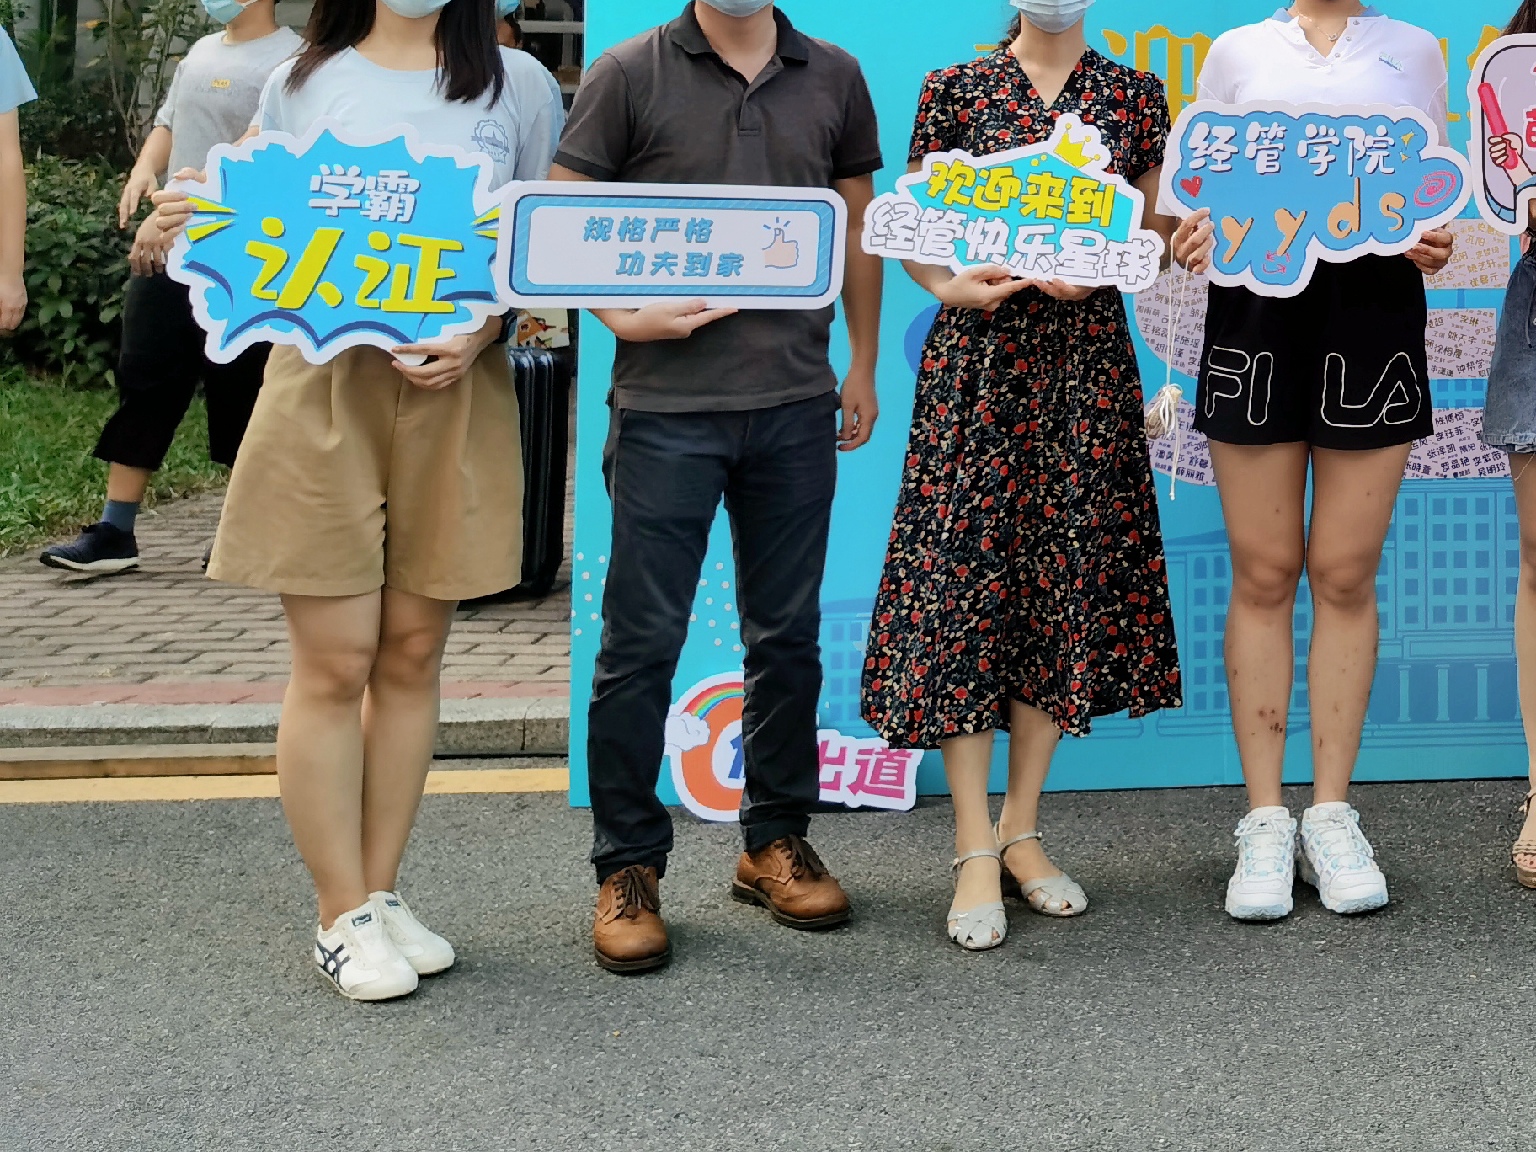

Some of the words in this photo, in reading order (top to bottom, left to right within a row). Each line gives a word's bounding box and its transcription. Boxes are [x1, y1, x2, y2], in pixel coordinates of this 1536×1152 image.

[1188, 121, 1396, 176] 经管学院
[308, 163, 421, 223] 学霸
[926, 158, 1117, 228] 欢迎来到
[583, 215, 714, 244] 规格严格
[870, 200, 1156, 286] 经管快乐星球
[245, 216, 465, 314] 认证
[614, 251, 745, 278] 功夫到家
[1204, 345, 1422, 428] FILA
